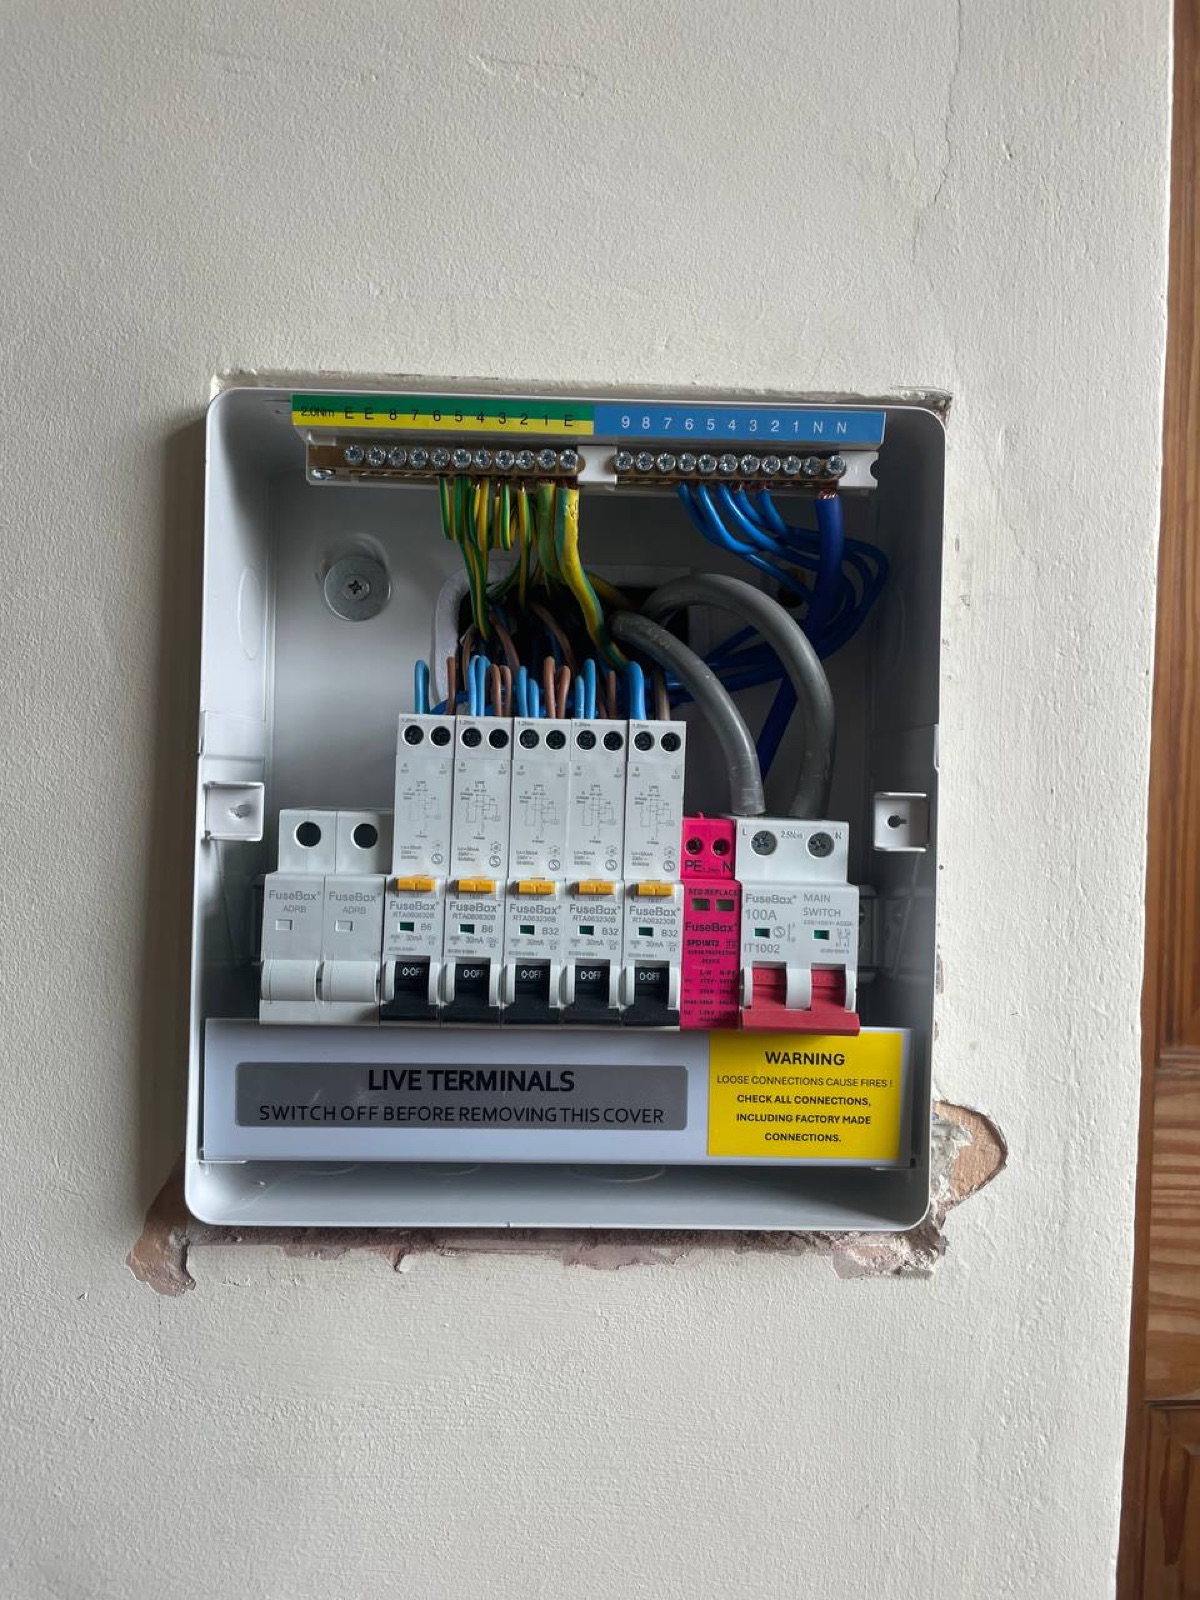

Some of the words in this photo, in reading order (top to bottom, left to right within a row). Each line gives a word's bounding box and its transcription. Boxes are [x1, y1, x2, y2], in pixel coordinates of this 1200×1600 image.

[345, 406, 354, 419] E
[364, 407, 374, 420] E
[389, 408, 397, 420] 8
[410, 409, 419, 420] 7
[433, 409, 441, 421] 6
[454, 410, 463, 422] 5
[476, 411, 485, 423] 4
[499, 412, 507, 425] 3
[520, 413, 528, 426] 2
[543, 414, 548, 426] 1
[564, 414, 574, 427] E
[620, 416, 630, 428] 9
[641, 417, 650, 430] 8
[663, 417, 672, 429] 7
[685, 418, 694, 430] 6
[706, 418, 715, 431] 5
[728, 419, 737, 431] 4
[749, 419, 758, 432] 3
[770, 420, 780, 432] 2
[793, 421, 799, 433] 1
[813, 421, 824, 433] N
[836, 421, 847, 434] N
[835, 832, 842, 840] N
[684, 860, 702, 872] PE
[722, 861, 734, 872] N
[803, 893, 831, 902] MAIN
[283, 904, 307, 913] ADRB
[342, 905, 367, 914] ADRB
[802, 907, 841, 917] SWITCH
[746, 909, 777, 921] 100A
[421, 923, 432, 931] B6
[481, 925, 493, 933] B6
[542, 927, 559, 935] B32
[601, 928, 619, 936] B32
[661, 929, 678, 937] B32
[744, 943, 780, 954] IT1002
[765, 1051, 845, 1066] WARNING
[368, 1070, 422, 1091] LIVE
[427, 1070, 575, 1092] TERMINALS
[717, 1075, 749, 1085] LOOSE
[751, 1075, 824, 1086] CONNECTIONS
[825, 1077, 858, 1087] CAUSE
[860, 1078, 887, 1088] FIRES
[737, 1094, 772, 1103] CHECK
[774, 1095, 791, 1104] ALL
[794, 1095, 871, 1107] CONNECTIONS,
[259, 1105, 336, 1121] SWITCH
[340, 1105, 379, 1121] OFF
[384, 1106, 455, 1121] BEFORE
[459, 1106, 557, 1122] REMOVING
[560, 1107, 600, 1122] THIS
[603, 1108, 664, 1123] COVER
[736, 1113, 793, 1122] INCLUDING
[795, 1114, 840, 1124] FACTORY
[842, 1115, 871, 1124] MADE
[764, 1132, 842, 1142] CONNECTIONS.
